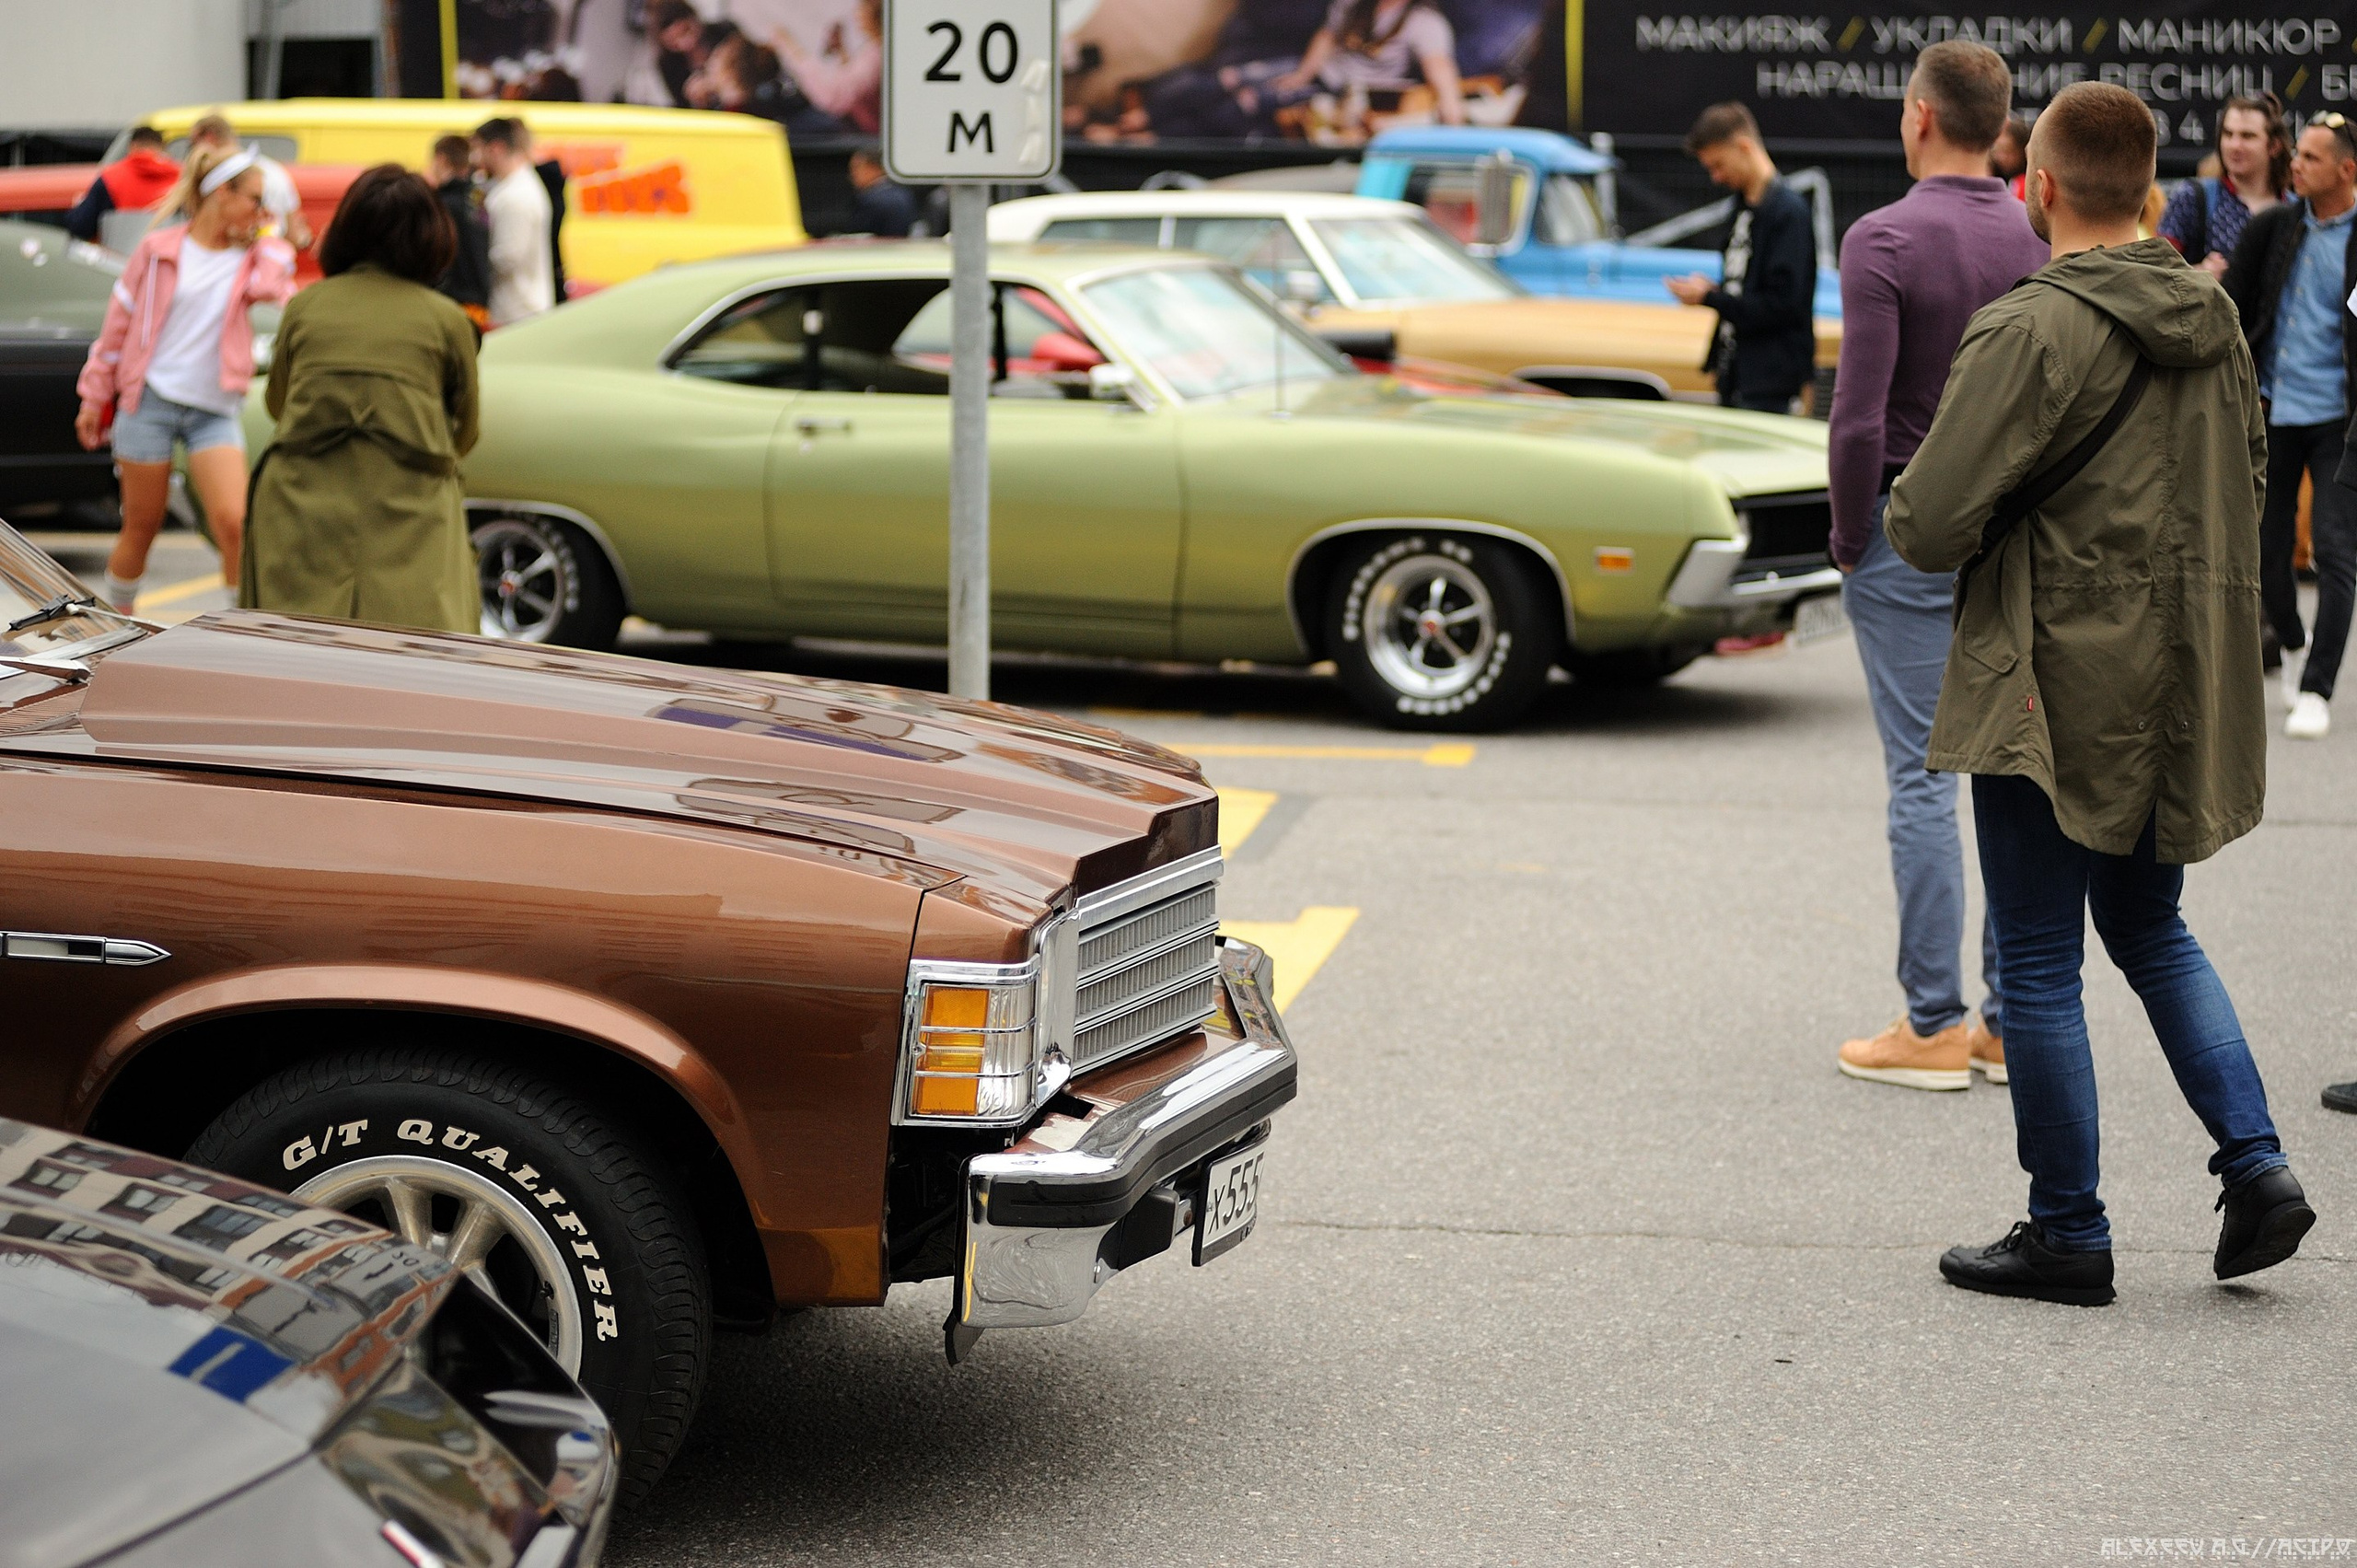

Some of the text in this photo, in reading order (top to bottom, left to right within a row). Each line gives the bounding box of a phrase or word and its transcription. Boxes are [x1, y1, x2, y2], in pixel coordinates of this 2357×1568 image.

[925, 21, 1017, 83] 20
[1636, 15, 1830, 52] МАКИЯЖ
[2119, 17, 2341, 55] МАНИКЮР
[283, 1119, 619, 1342] G/T QUALIFIER
